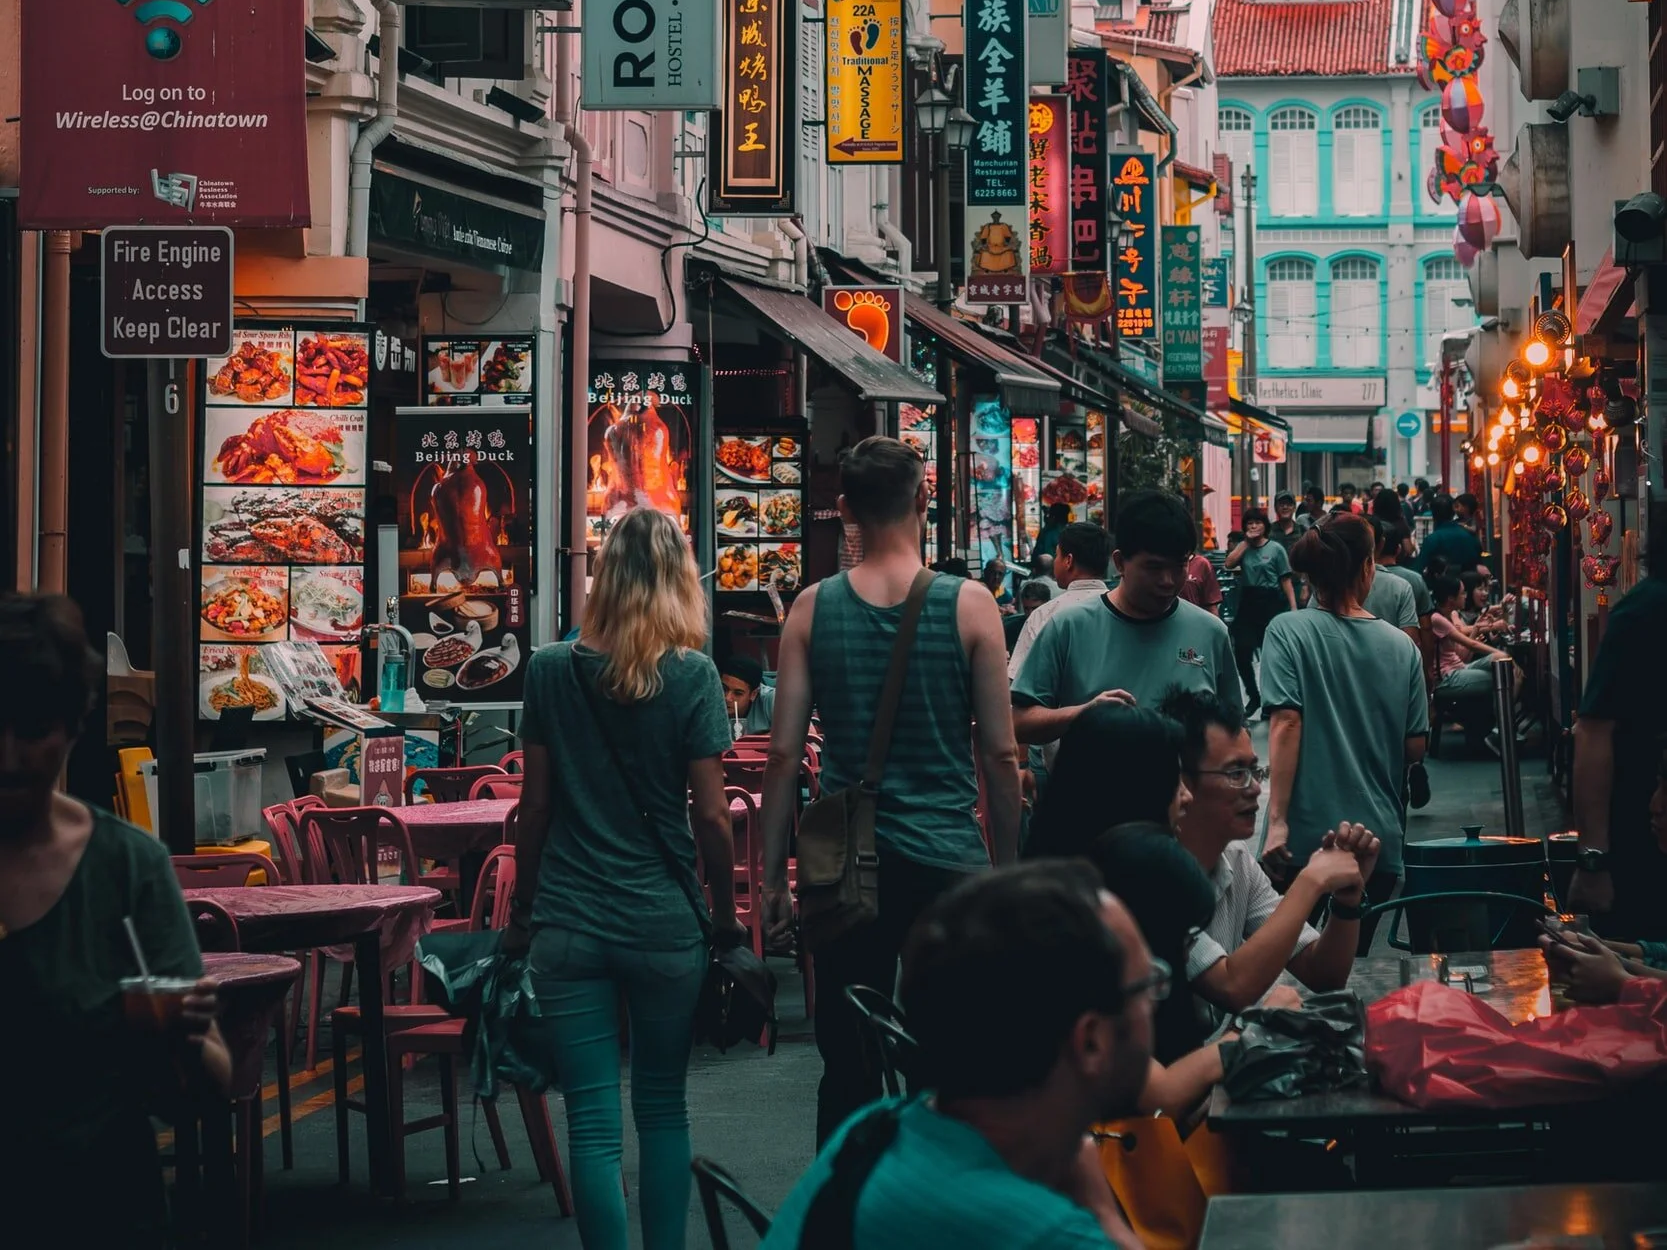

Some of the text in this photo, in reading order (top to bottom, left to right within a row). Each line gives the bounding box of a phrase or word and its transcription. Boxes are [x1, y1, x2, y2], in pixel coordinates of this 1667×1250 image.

[853, 5, 876, 17] 22A
[668, 12, 682, 87] HOSTEL
[842, 57, 889, 66] Traditional
[122, 84, 206, 104] Log on to
[857, 66, 872, 139] MASSAGE
[56, 111, 268, 131] Wireless@Chinatown
[975, 168, 1017, 176] Restaurant
[88, 186, 140, 196] Supported by:
[986, 179, 1006, 187] TEL:
[114, 240, 221, 268] Fire Engine
[132, 278, 203, 300] Access
[113, 316, 221, 344] Keep Clear
[588, 393, 692, 406] Beijing Duck
[415, 450, 514, 463] Beijing Duck
